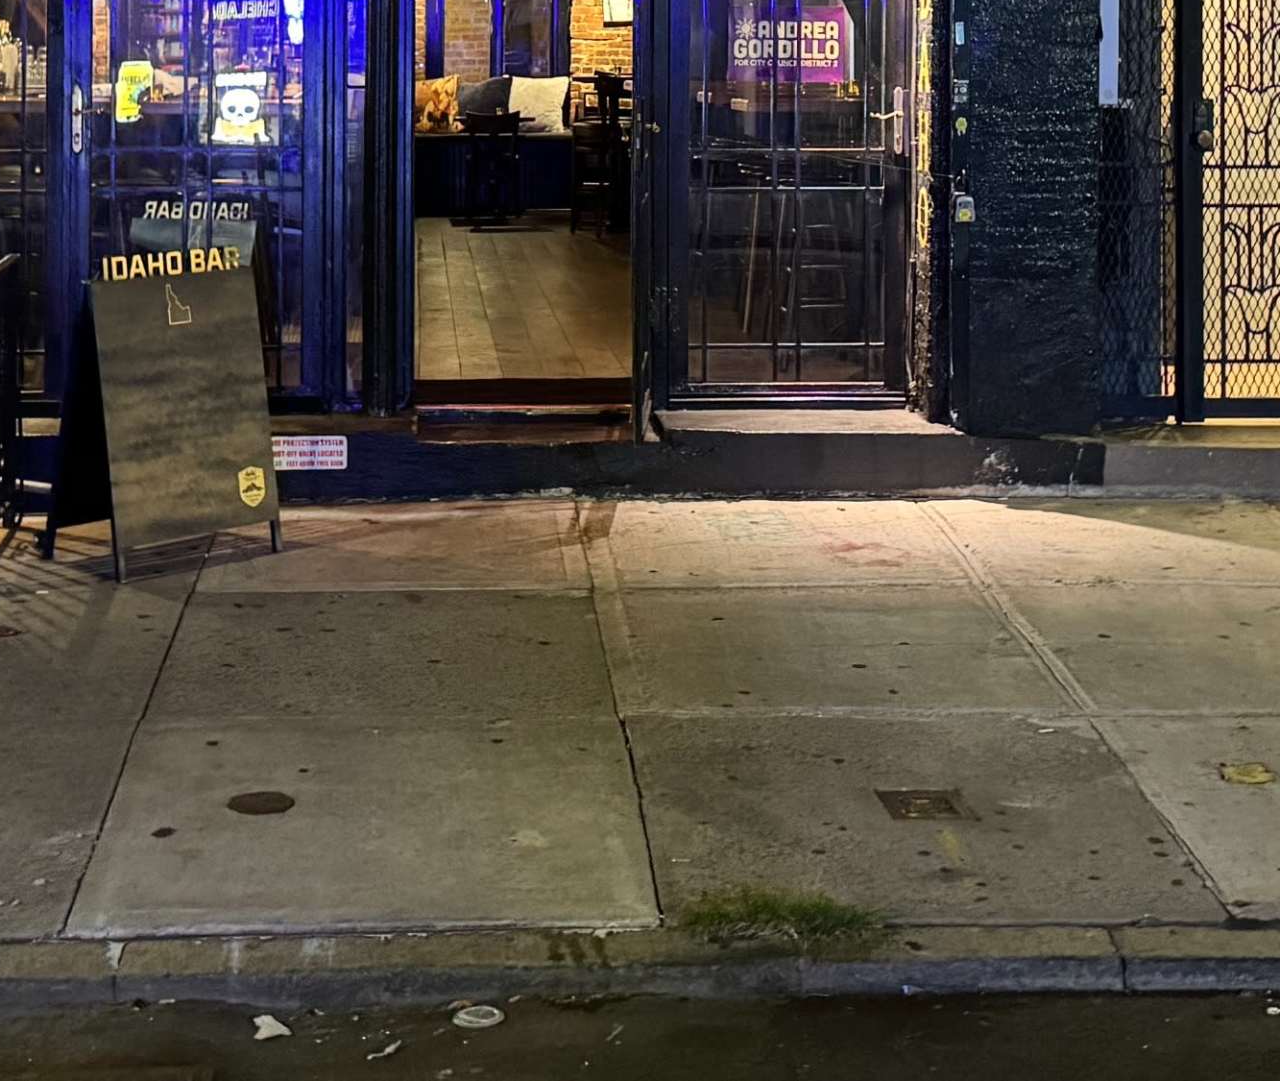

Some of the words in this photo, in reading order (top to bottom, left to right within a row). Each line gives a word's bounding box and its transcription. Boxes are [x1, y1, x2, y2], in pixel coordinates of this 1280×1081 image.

[757, 20, 839, 39] ANDREA
[733, 38, 840, 60] GORDILLO
[102, 250, 183, 281] IDAHO
[189, 246, 240, 273] BAR
